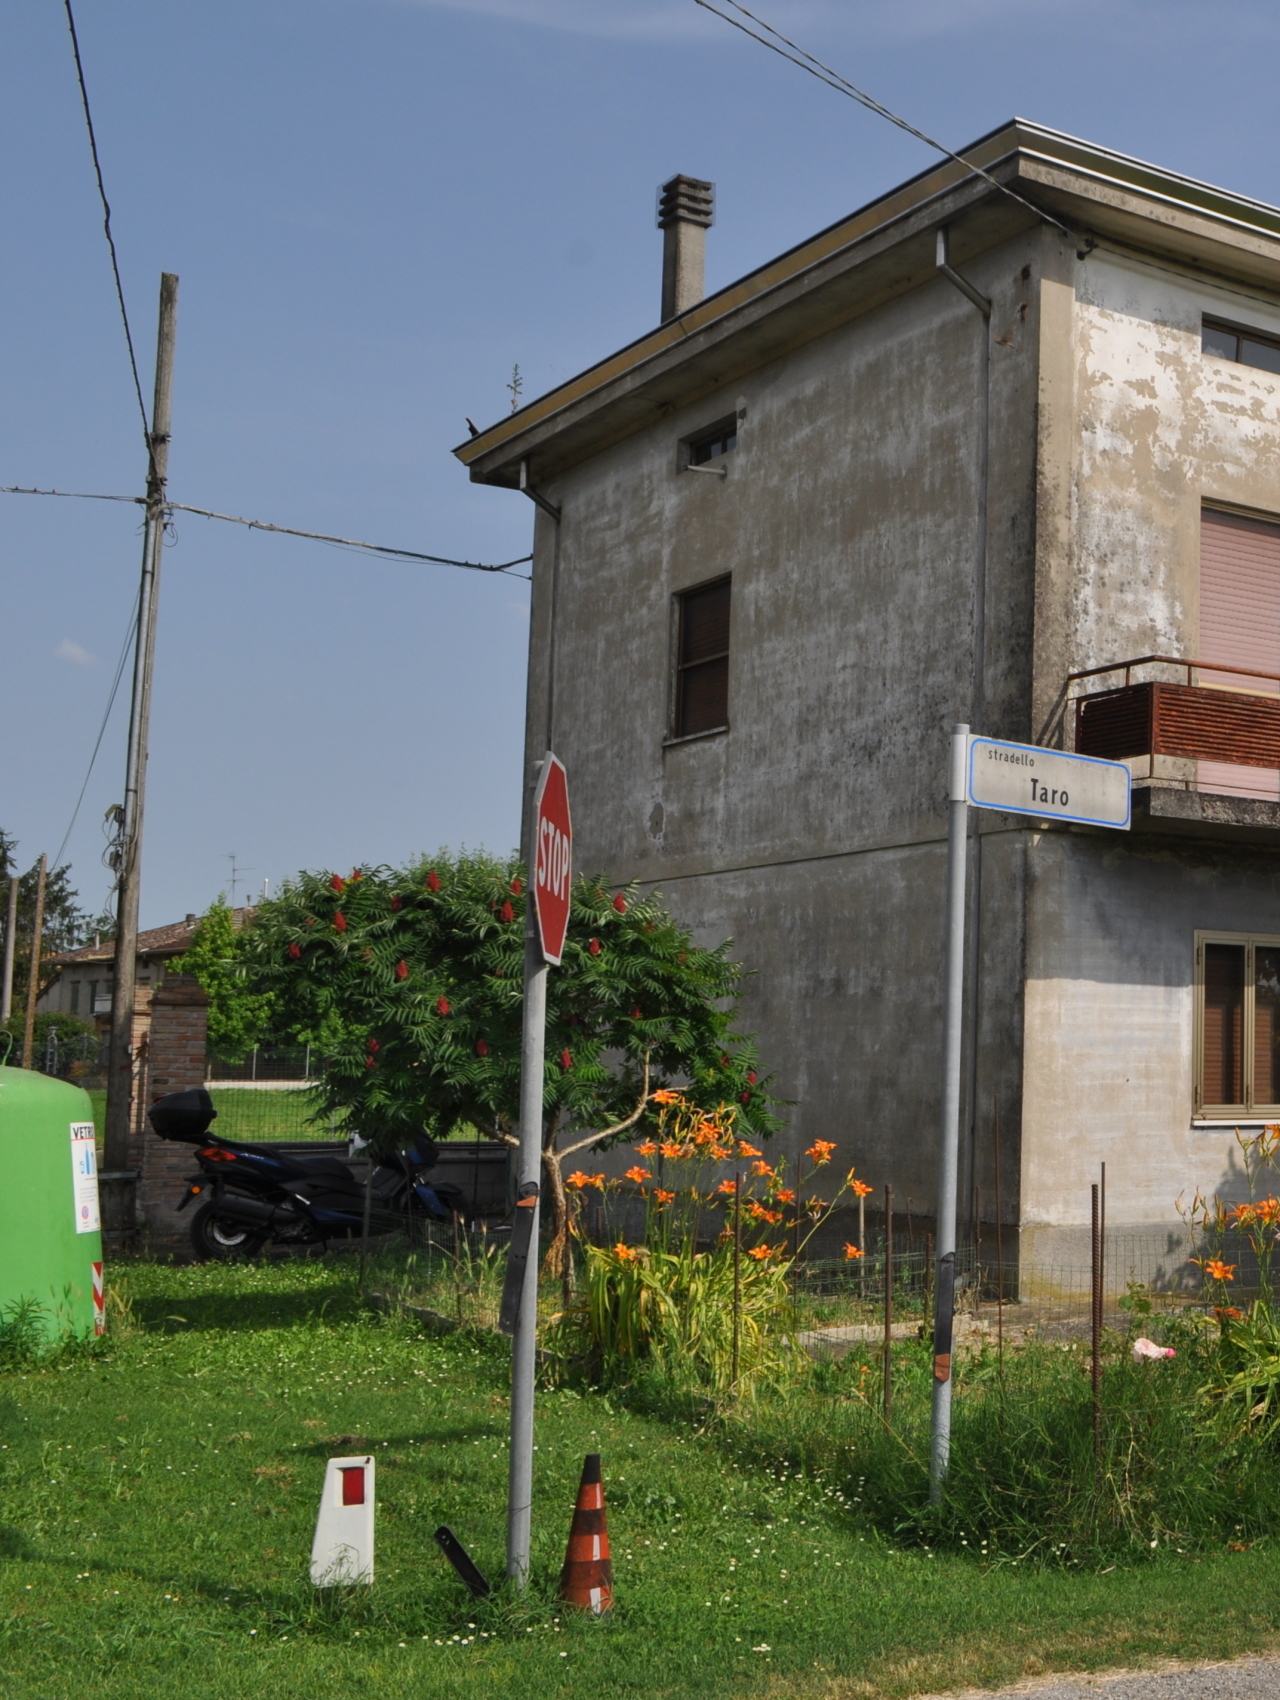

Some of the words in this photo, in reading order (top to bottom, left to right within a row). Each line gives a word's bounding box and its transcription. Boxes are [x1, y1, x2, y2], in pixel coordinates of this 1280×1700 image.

[988, 749, 1035, 767] stradello
[1030, 778, 1069, 806] Taro
[538, 816, 569, 901] STOP
